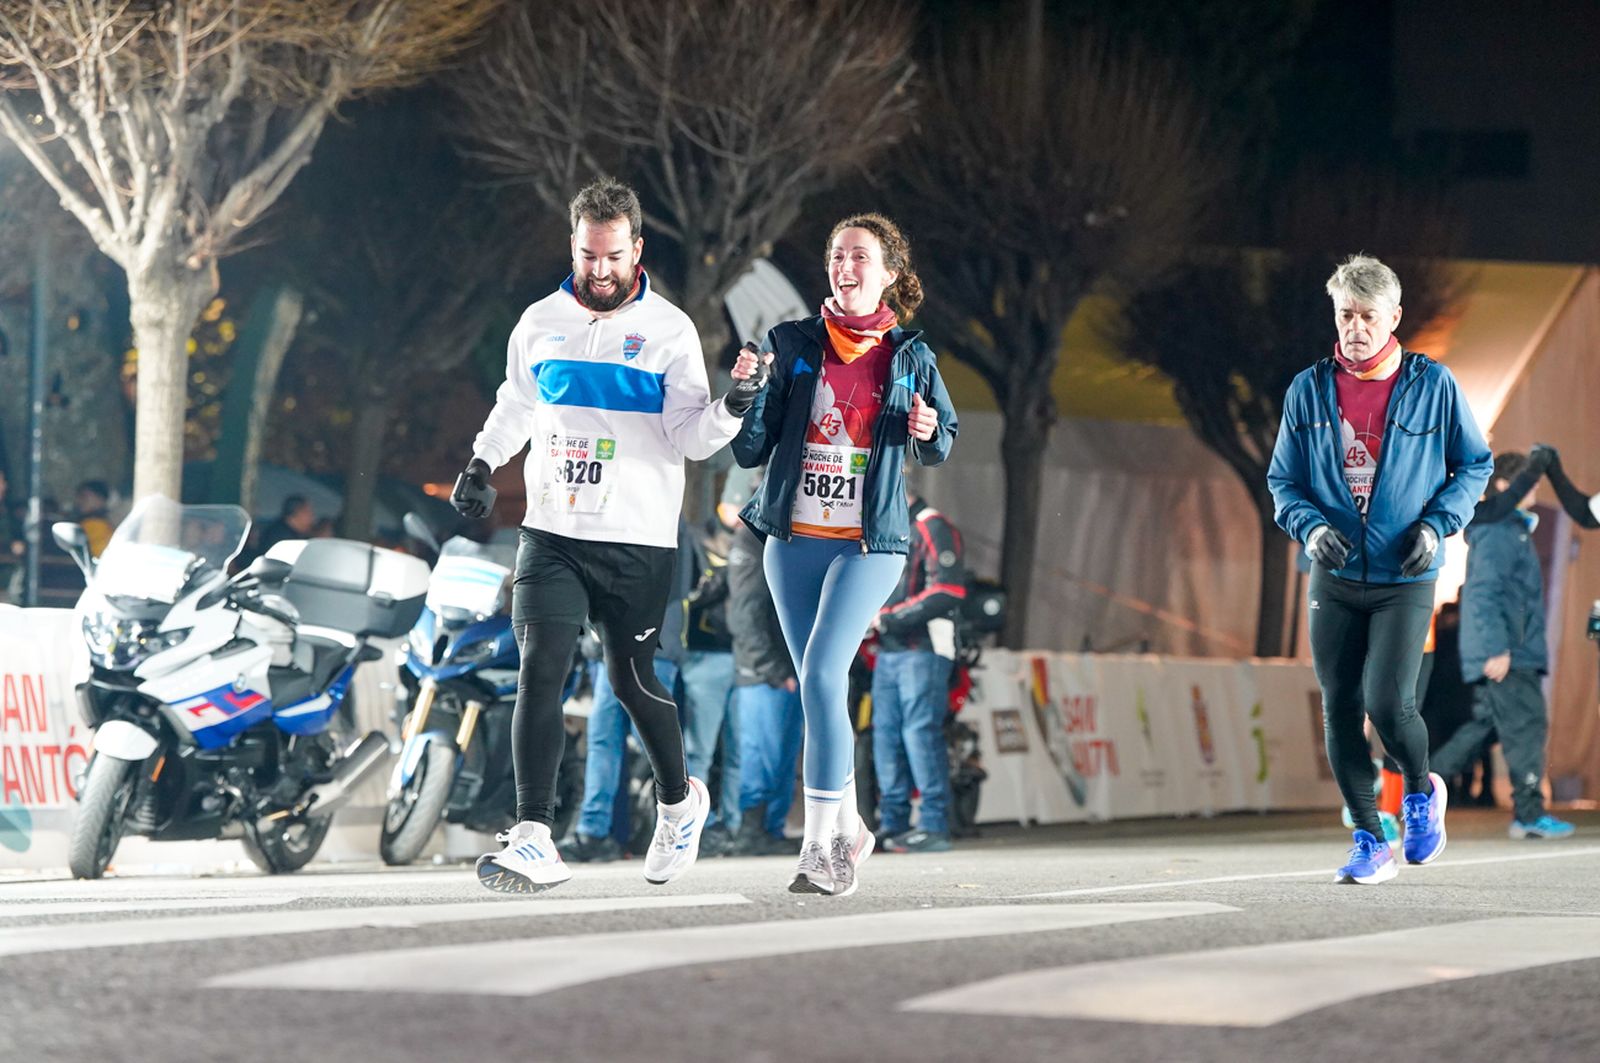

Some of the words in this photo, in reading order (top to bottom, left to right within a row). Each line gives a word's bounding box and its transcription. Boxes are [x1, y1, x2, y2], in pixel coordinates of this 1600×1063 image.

[820, 413, 842, 436] 43
[806, 451, 832, 463] NOCHE
[833, 454, 843, 464] DE
[1346, 446, 1366, 467] 43
[803, 472, 856, 500] 5821
[0, 673, 47, 733] AN
[3, 724, 94, 805] ANTÓ
